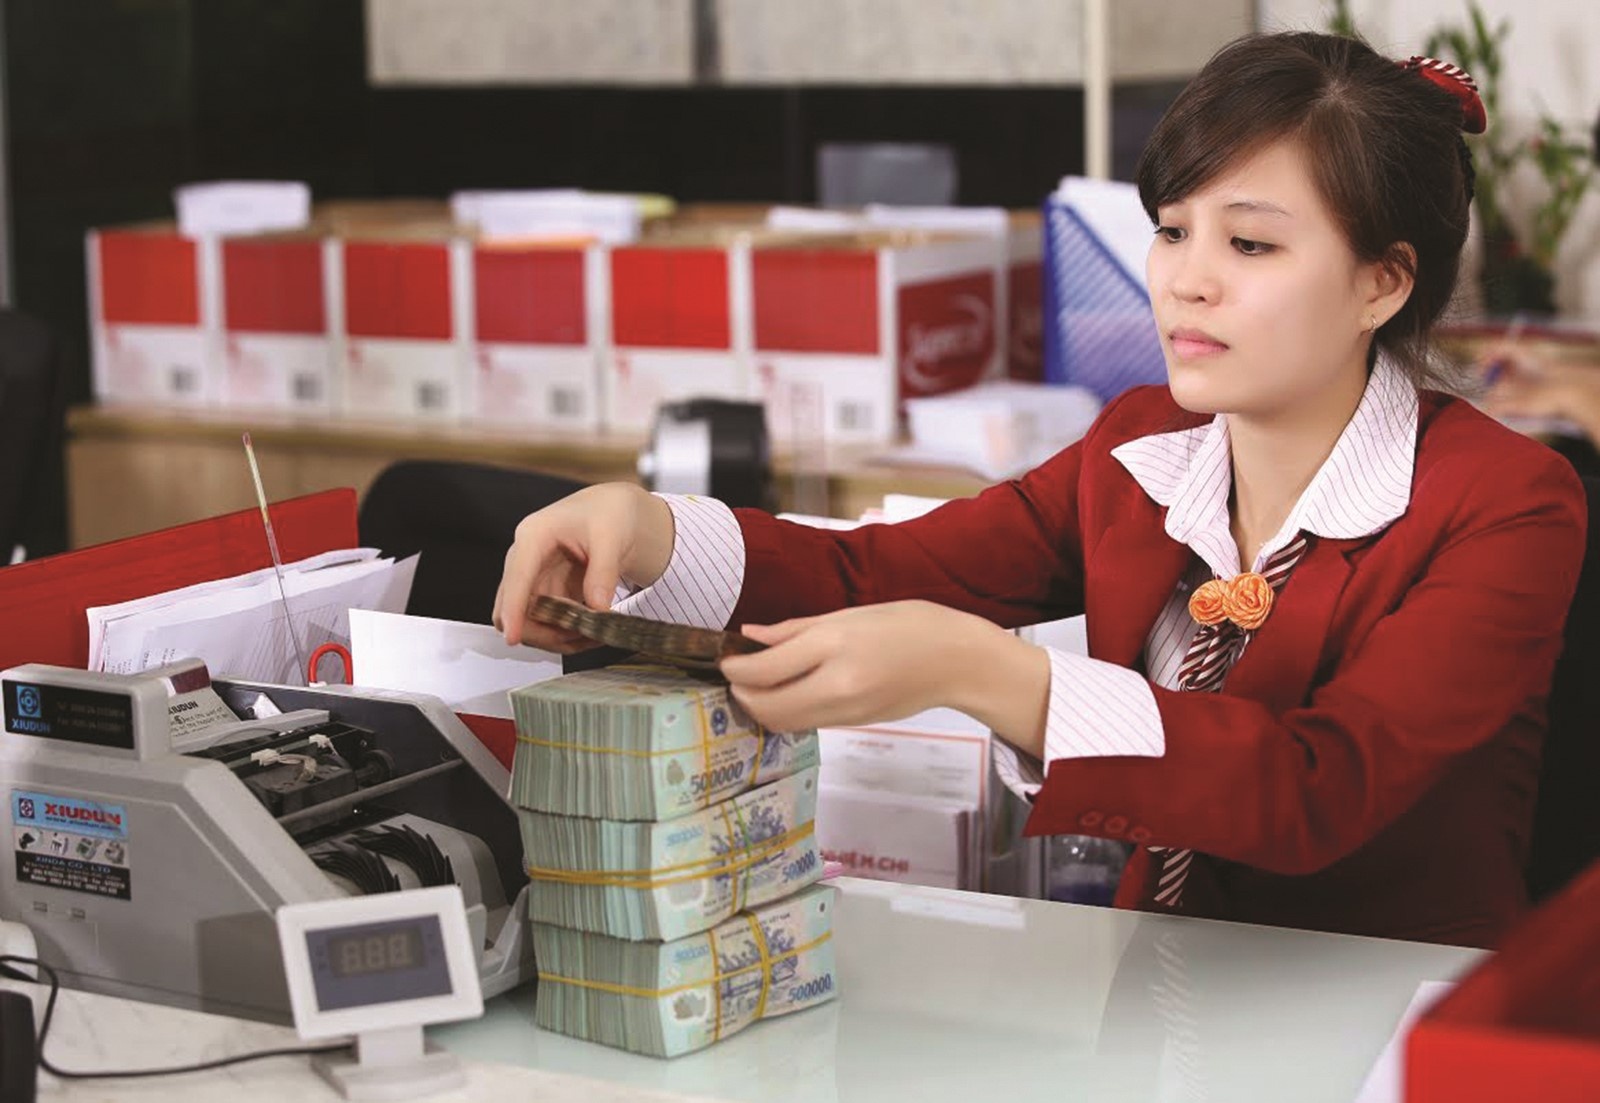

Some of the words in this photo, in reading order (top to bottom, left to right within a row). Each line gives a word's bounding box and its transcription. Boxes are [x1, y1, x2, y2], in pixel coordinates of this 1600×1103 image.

[12, 718, 50, 733] XIUDUN
[690, 761, 744, 795] 500000
[45, 803, 121, 825] XIUDUN
[788, 974, 832, 1003] 500000
